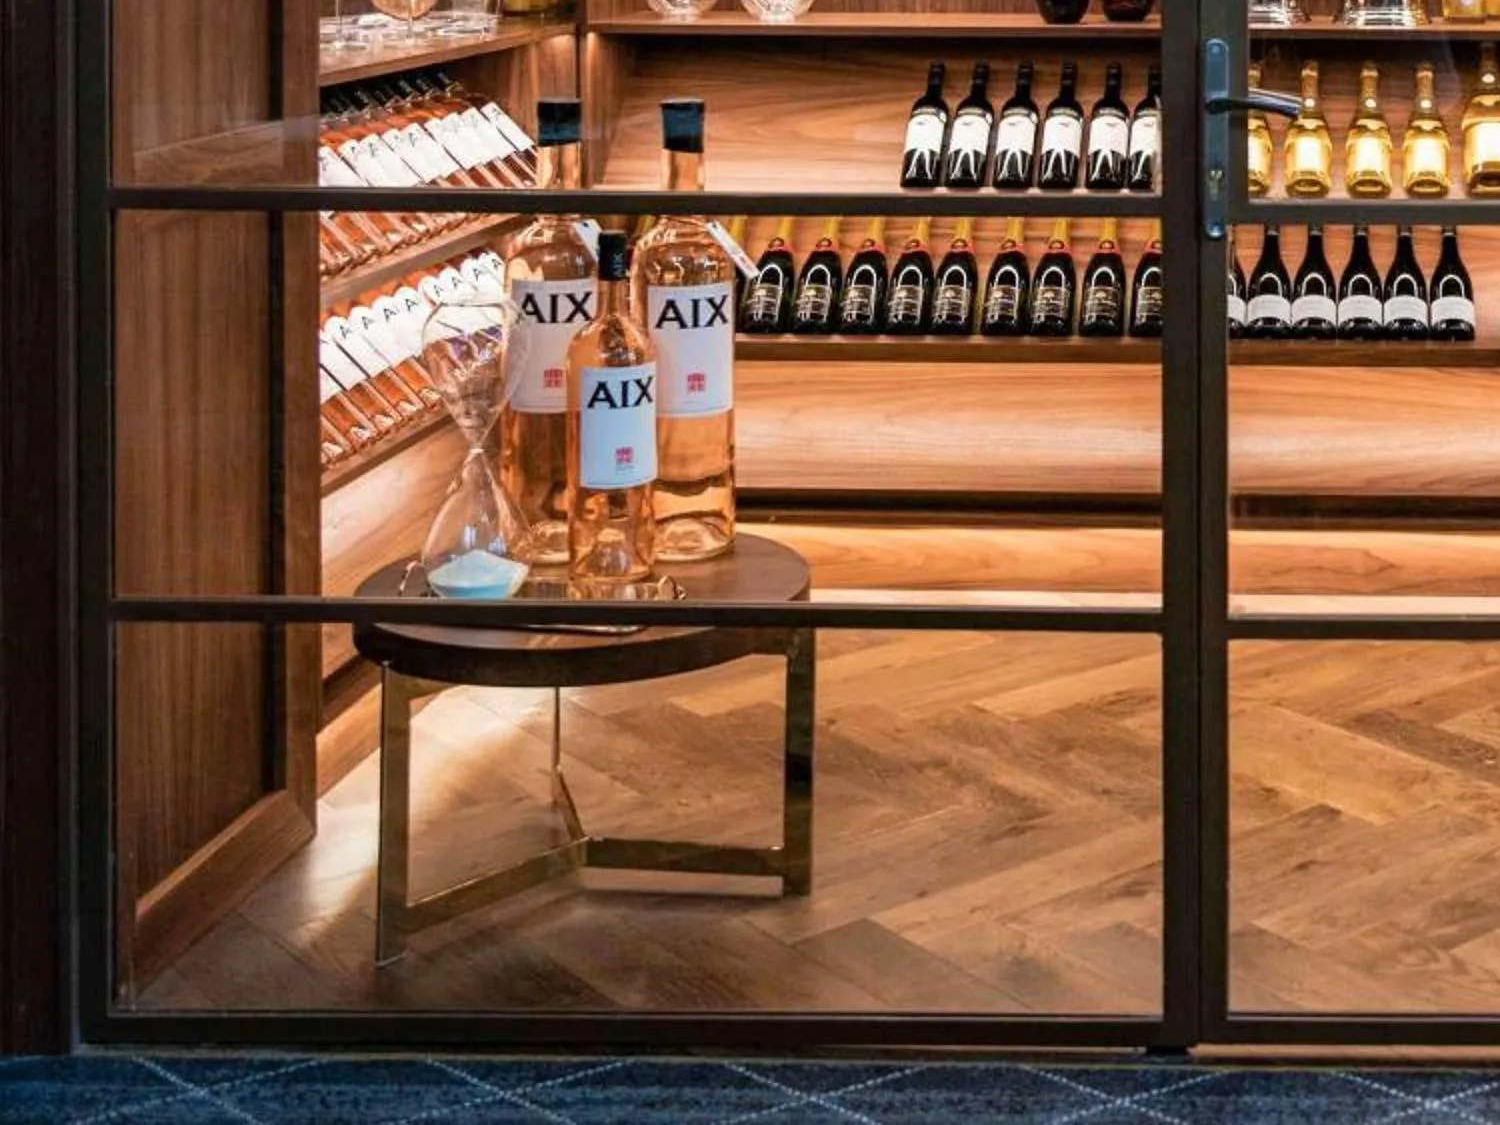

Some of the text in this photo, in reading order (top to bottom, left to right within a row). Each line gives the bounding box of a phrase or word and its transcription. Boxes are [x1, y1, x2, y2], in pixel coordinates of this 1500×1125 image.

[520, 291, 594, 324] AIX
[655, 294, 729, 330] AIX
[587, 375, 654, 410] AIX
